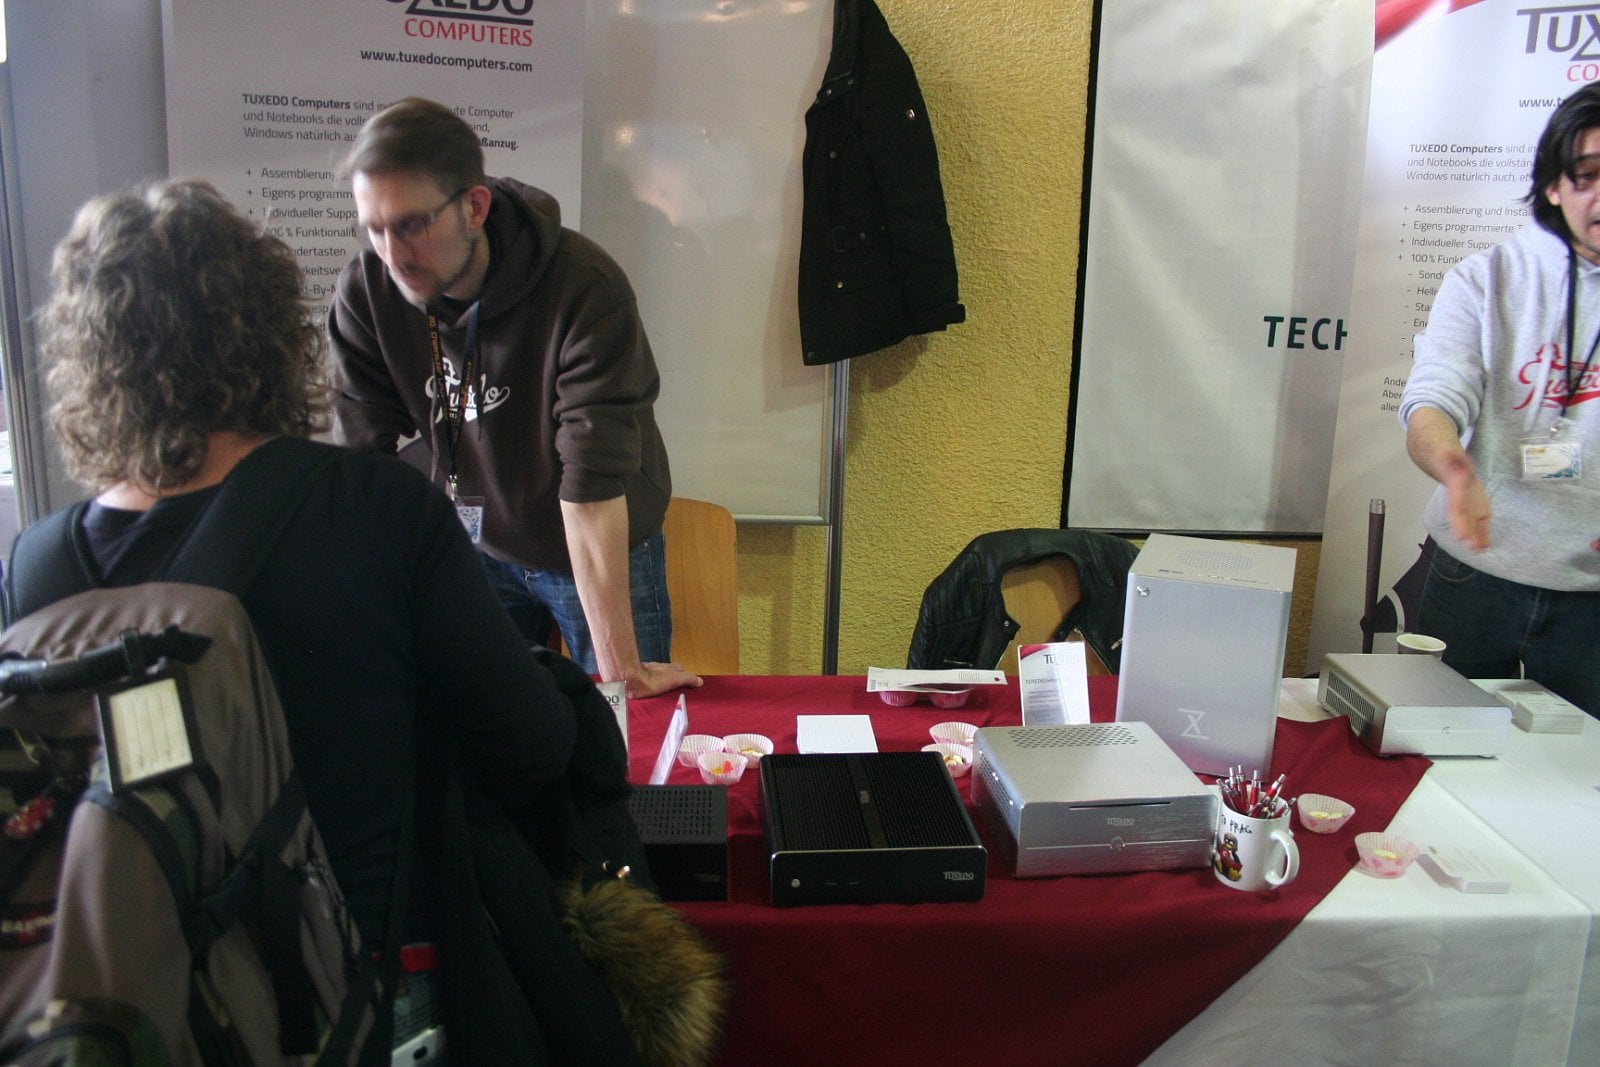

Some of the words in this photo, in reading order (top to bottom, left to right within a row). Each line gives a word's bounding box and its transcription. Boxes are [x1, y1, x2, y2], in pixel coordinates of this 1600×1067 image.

[404, 18, 533, 47] COMPUTERS
[360, 50, 532, 72] www.tuxedocomputers.com
[243, 94, 289, 106] TUXEDO
[292, 97, 351, 110] Computers
[354, 100, 374, 111] sind
[243, 112, 264, 121] und
[266, 112, 324, 124] Notebooks
[327, 115, 342, 125] die
[468, 106, 514, 119] Computer
[243, 127, 293, 139] Windows
[1410, 144, 1448, 153] TUXEDO
[1450, 144, 1503, 155] Computers
[1506, 144, 1525, 153] sind
[1408, 158, 1424, 167] und
[1427, 158, 1477, 168] Notebooks
[1480, 159, 1494, 168] die
[1406, 171, 1448, 181] Windows
[262, 187, 296, 200] Eigens
[299, 190, 353, 201] programm
[1415, 204, 1482, 217] Assemblierung
[1485, 207, 1502, 216] und
[1413, 220, 1443, 232] Eigens
[1445, 223, 1514, 234] programmierte
[1412, 237, 1464, 248] Individueller
[1412, 254, 1428, 262] 100
[1416, 303, 1432, 312] Sta
[1382, 390, 1402, 399] Aber
